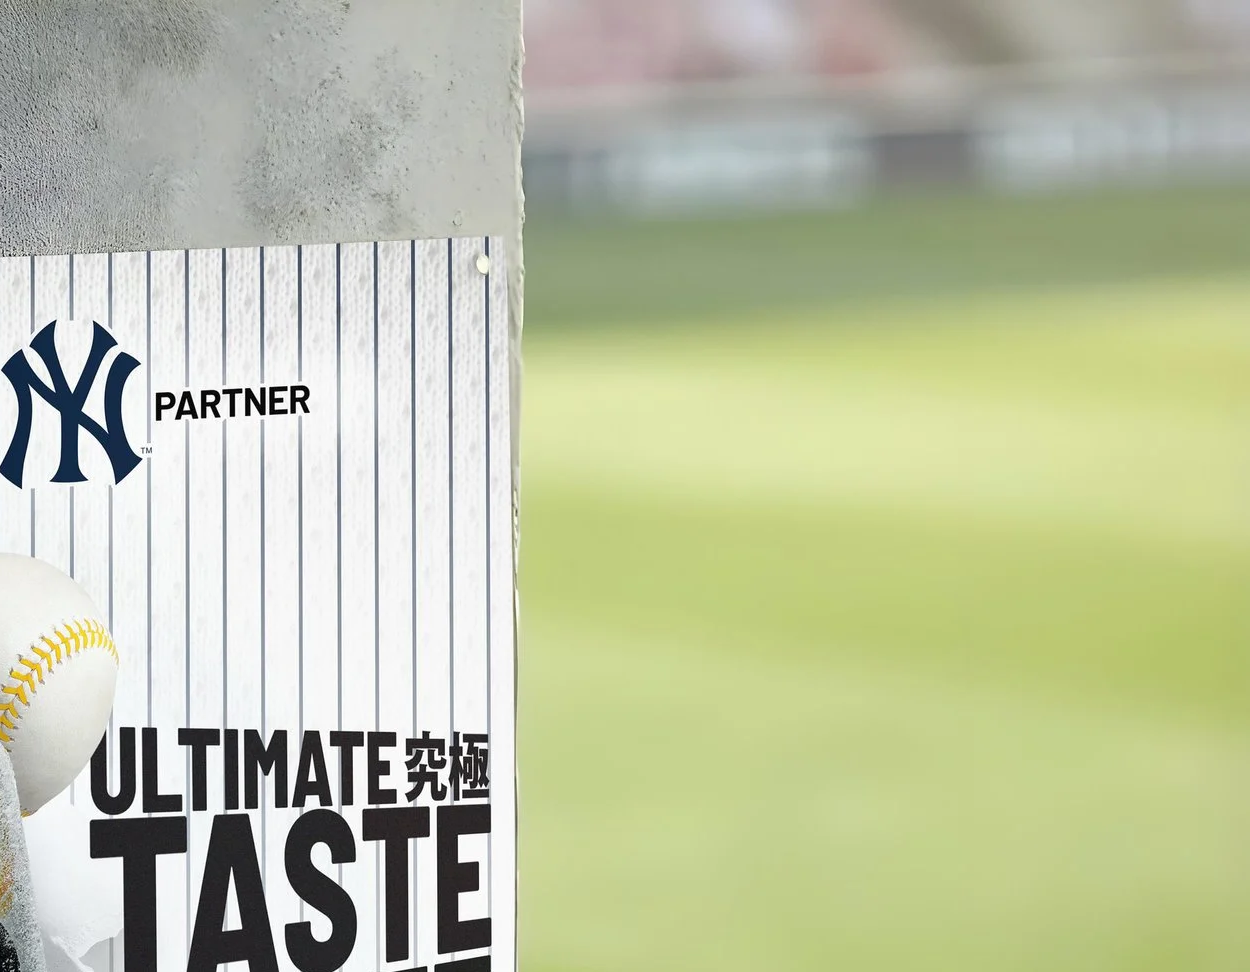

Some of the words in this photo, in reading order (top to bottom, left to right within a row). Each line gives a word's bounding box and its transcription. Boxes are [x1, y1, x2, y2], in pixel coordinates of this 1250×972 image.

[155, 384, 311, 421] PARTNER
[89, 727, 397, 815] ULTIMATE
[404, 731, 490, 803] 究極
